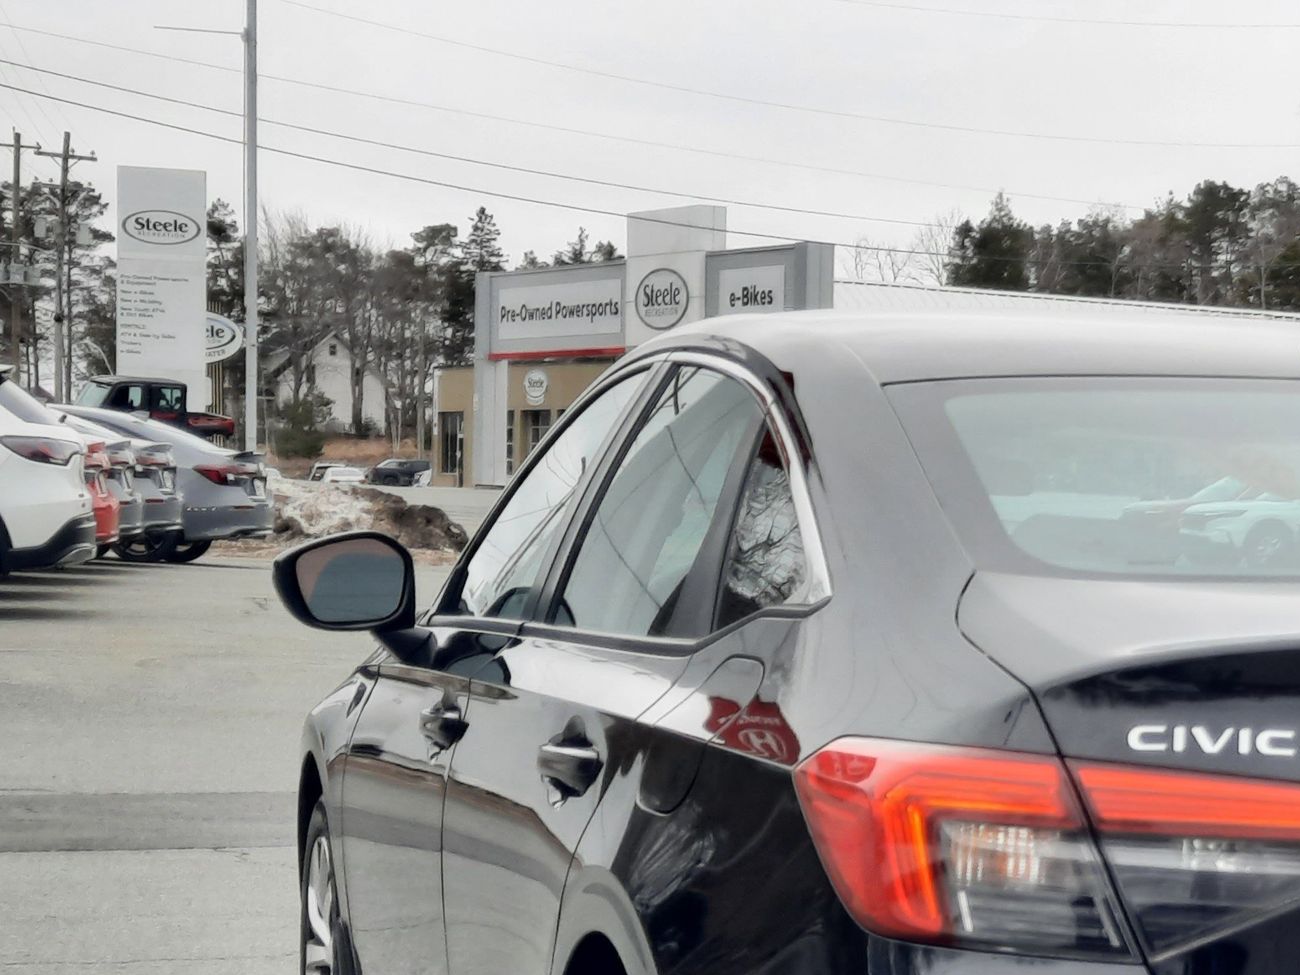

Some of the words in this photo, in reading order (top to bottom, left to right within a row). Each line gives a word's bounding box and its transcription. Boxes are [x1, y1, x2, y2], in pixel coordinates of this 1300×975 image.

[134, 216, 189, 233] Steele
[642, 281, 681, 308] Steele
[729, 285, 773, 307] e-Bikes
[500, 300, 553, 323] Pre-Owned
[555, 297, 619, 323] Powersports
[1126, 724, 1298, 757] CIVIC
